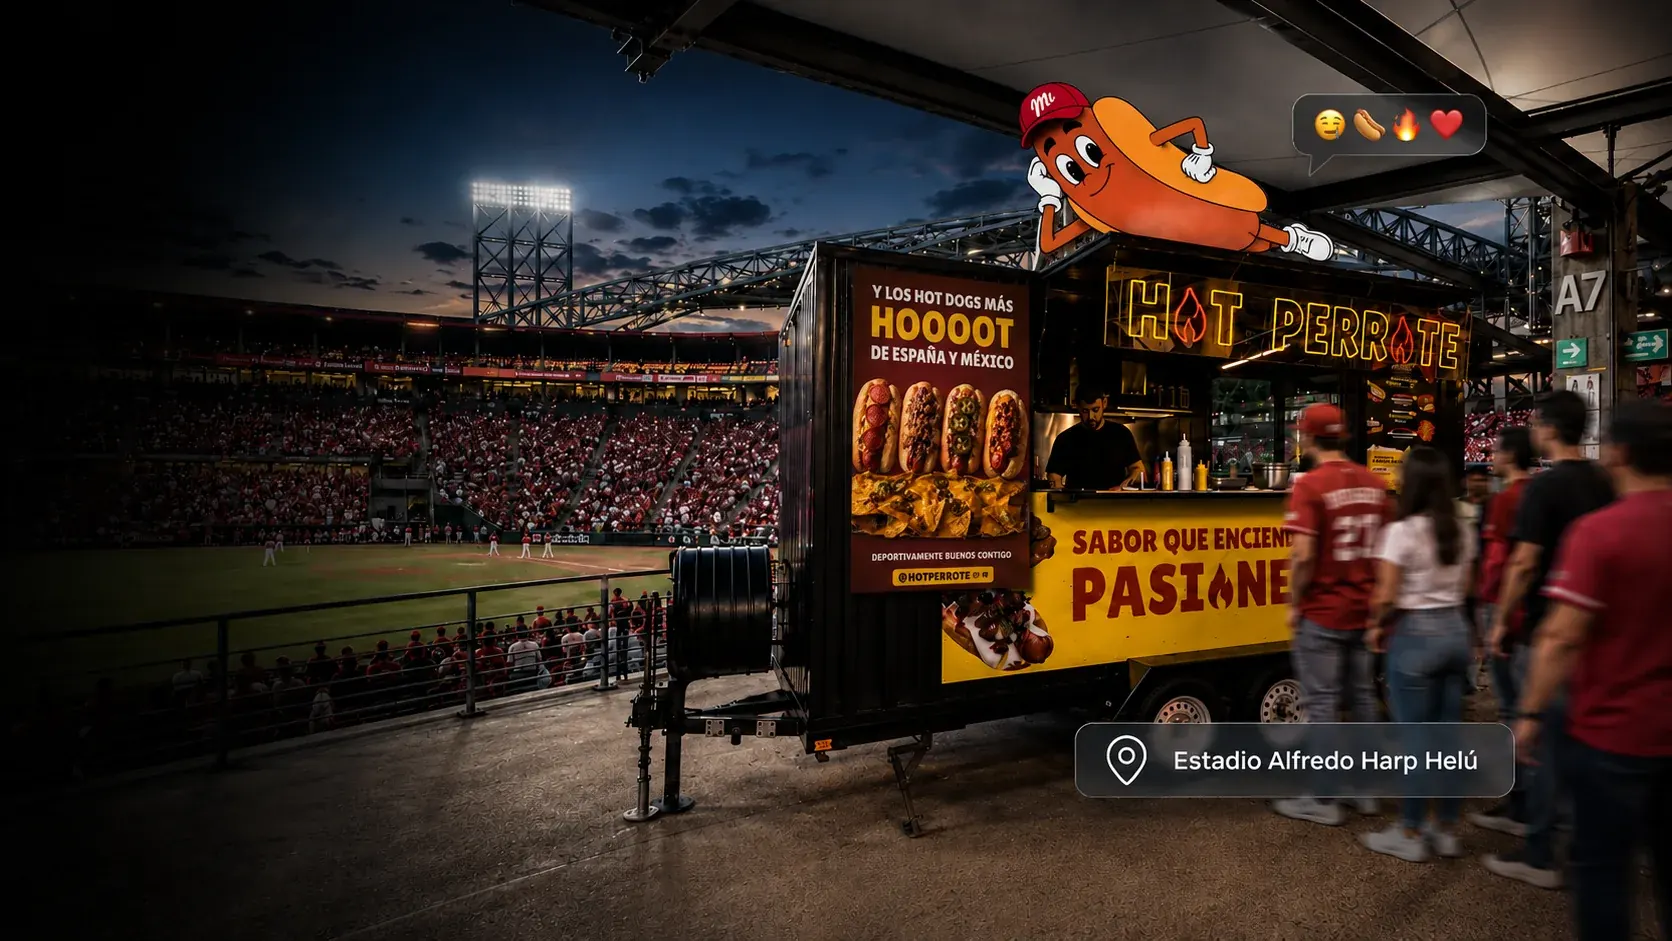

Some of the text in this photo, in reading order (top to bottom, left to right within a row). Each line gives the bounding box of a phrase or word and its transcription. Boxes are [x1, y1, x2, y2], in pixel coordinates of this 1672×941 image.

[872, 284, 1014, 313] Y LOS HOT DOGS MÁS
[1555, 270, 1607, 315] A7
[871, 305, 1014, 349] HOOOOT
[870, 345, 1014, 370] DE ESPAÑA Y MÉXICO
[1072, 529, 1158, 555] SABOR
[1163, 528, 1209, 555] QUE
[871, 550, 1012, 561] DEPORTIVAMENTE BUENOS CONTIGO
[898, 570, 971, 582] @HOTPERROTE
